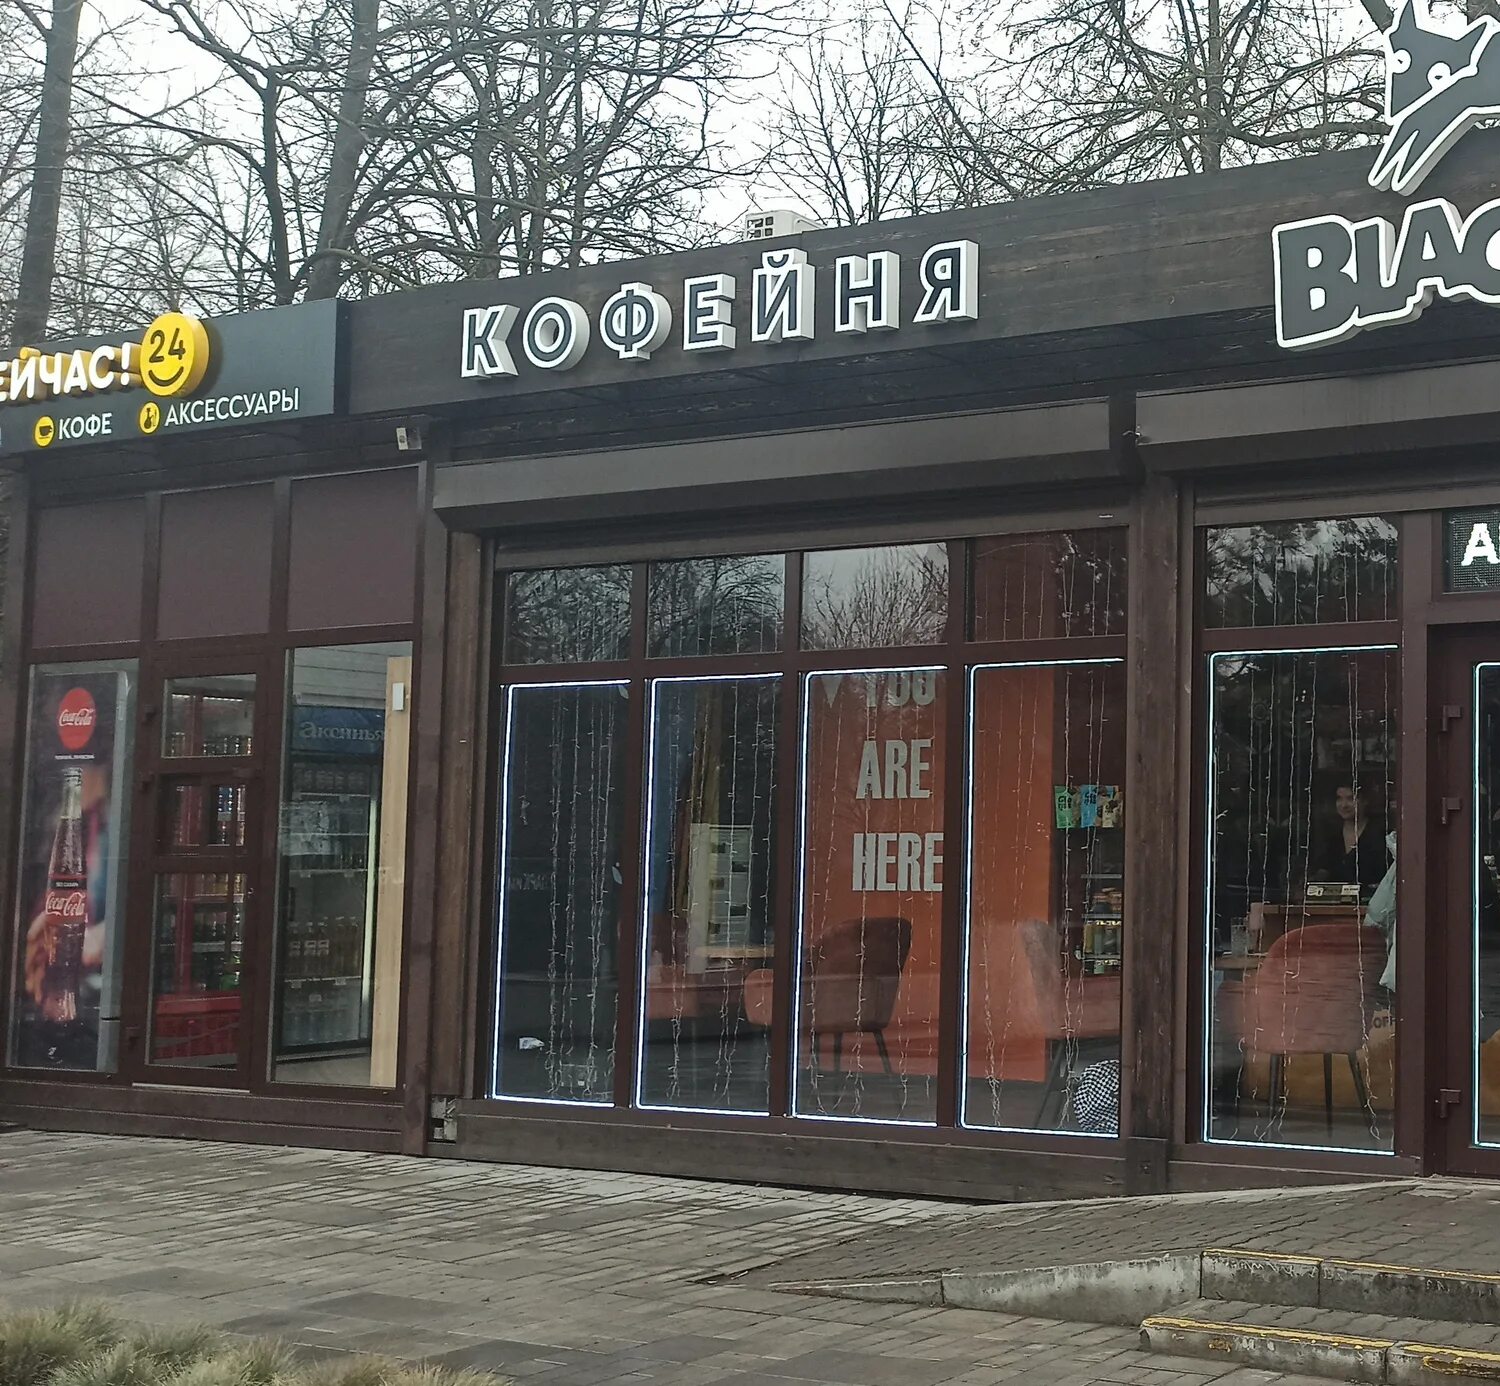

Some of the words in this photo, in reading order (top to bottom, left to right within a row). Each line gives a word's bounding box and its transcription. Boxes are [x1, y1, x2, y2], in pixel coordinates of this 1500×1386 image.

[461, 240, 979, 378] КОФЕЙНЯ
[149, 328, 187, 364] 24
[58, 412, 112, 440] КОФЕ
[164, 387, 300, 428] АКСЕССУАРЫ
[856, 738, 932, 799] ARE
[852, 832, 944, 892] HERE
